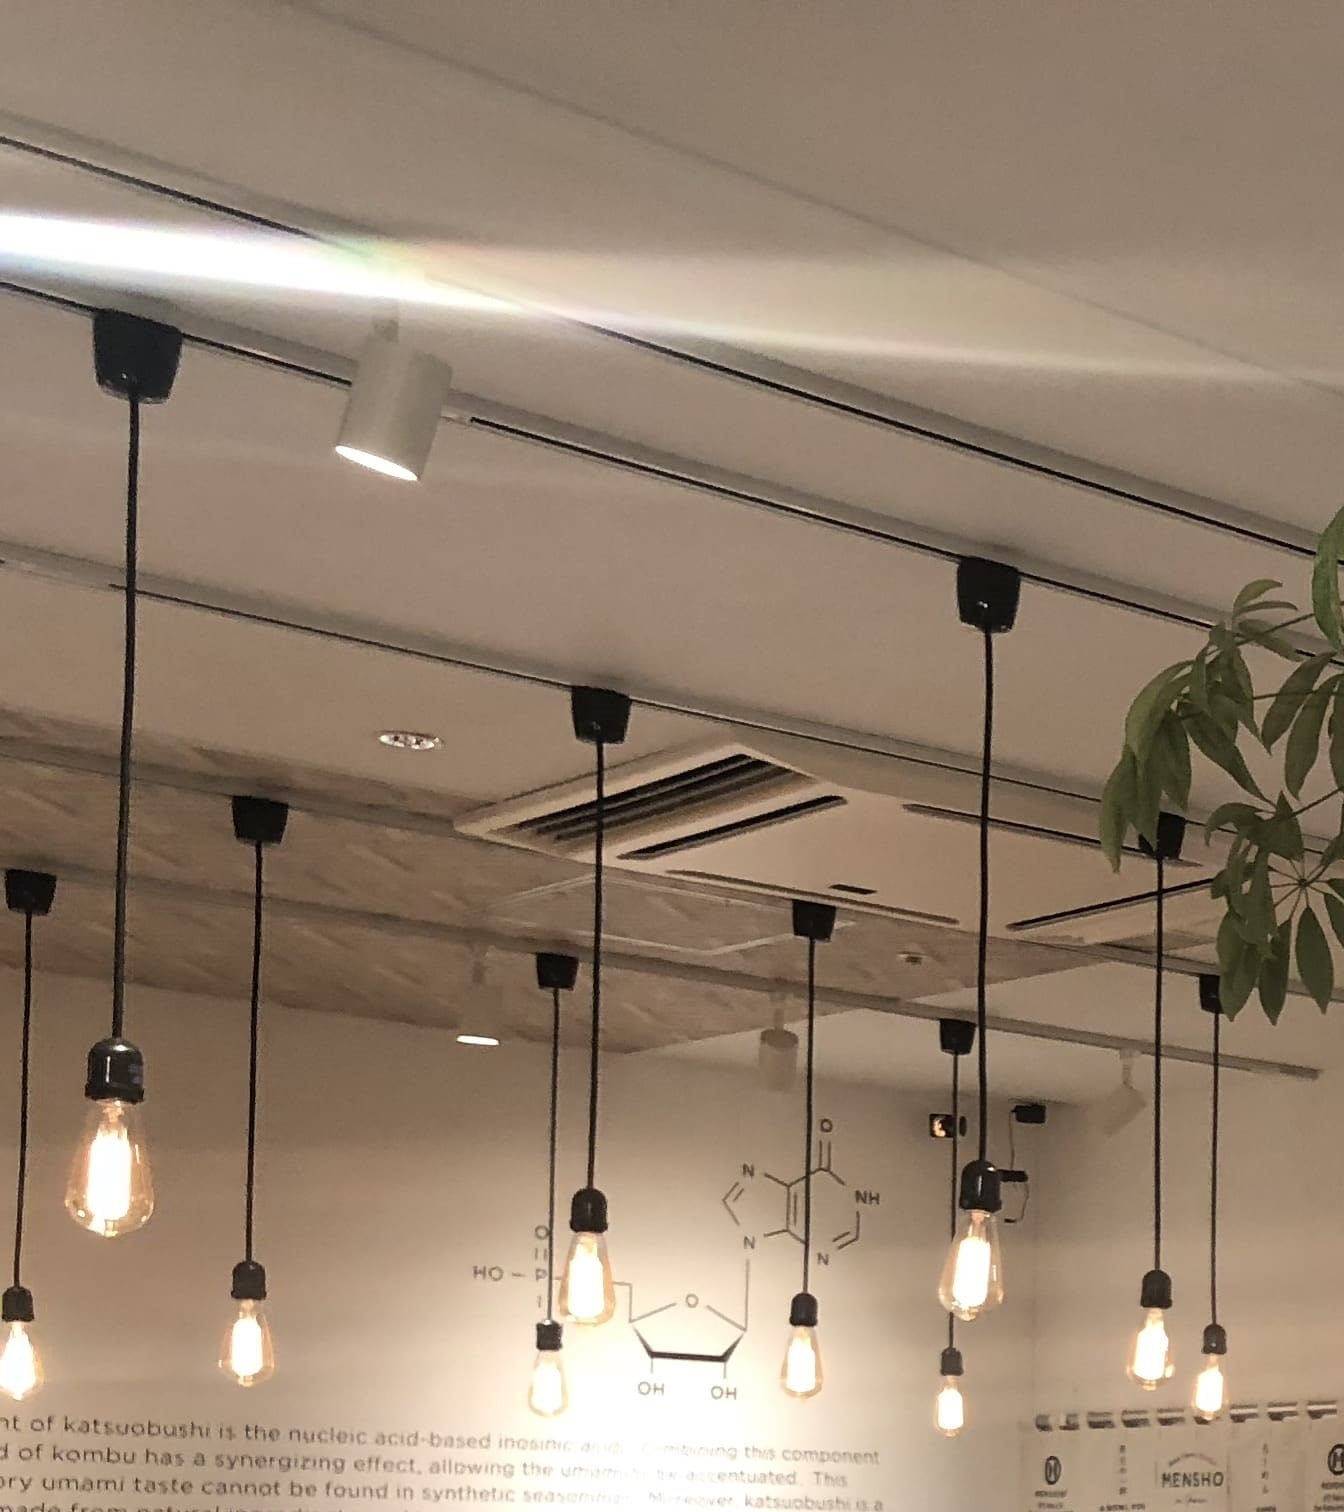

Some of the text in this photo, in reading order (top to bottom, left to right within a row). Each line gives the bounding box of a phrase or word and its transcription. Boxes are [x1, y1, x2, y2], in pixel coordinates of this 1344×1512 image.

[742, 1164, 755, 1178] N
[855, 1190, 880, 1205] NH
[743, 1236, 755, 1250] N
[817, 1253, 829, 1265] N
[473, 1266, 504, 1282] HO
[685, 1294, 699, 1309] O
[637, 1381, 665, 1397] OH
[711, 1385, 738, 1400] OH
[30, 1415, 55, 1432] of
[64, 1416, 210, 1439] katsuobushi
[217, 1423, 236, 1440] is
[245, 1424, 280, 1442] the
[289, 1427, 367, 1445] nucleic
[744, 1445, 776, 1460] this
[782, 1450, 880, 1467] component
[19, 1444, 43, 1461] of
[52, 1444, 136, 1464] kombu
[144, 1448, 184, 1466] has
[193, 1452, 205, 1466] a
[215, 1454, 345, 1474] synergizing
[428, 1459, 515, 1478] allowing
[522, 1462, 554, 1477] the
[813, 1472, 848, 1487] This
[1162, 1471, 1224, 1488] MENSHO
[41, 1477, 124, 1493] umami
[133, 1478, 193, 1494] taste
[201, 1481, 280, 1496] cannot
[290, 1480, 317, 1497] be
[325, 1481, 388, 1499] found
[396, 1486, 414, 1500] in
[422, 1484, 515, 1502] synthetic
[745, 1493, 851, 1511] katsuobushi
[856, 1500, 869, 1512] is
[874, 1500, 884, 1512] a
